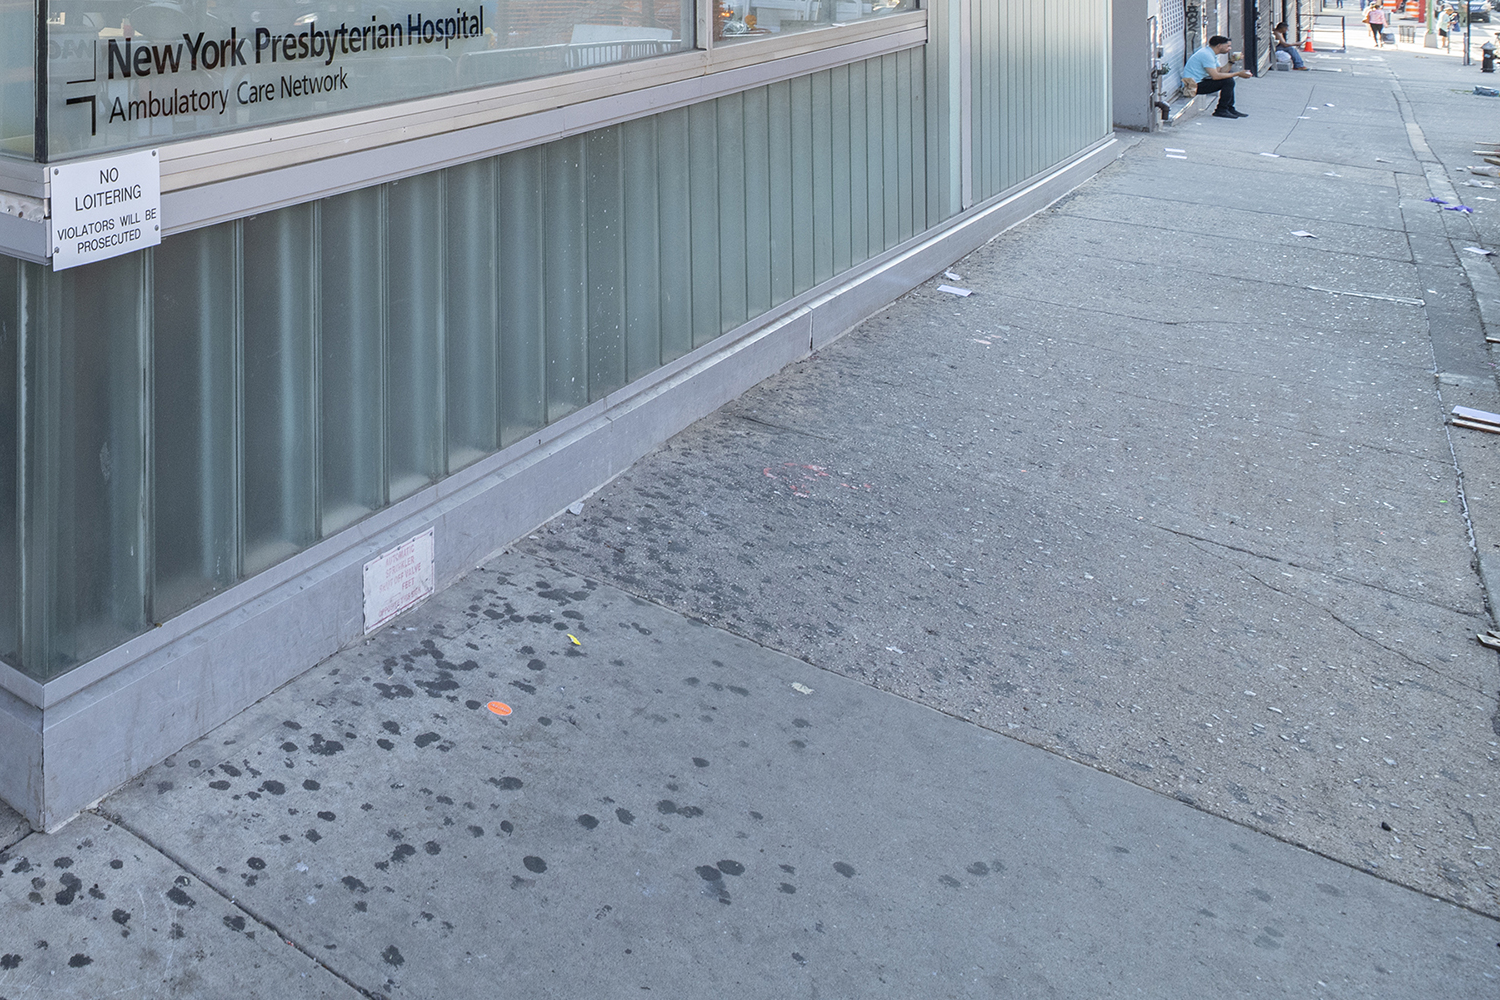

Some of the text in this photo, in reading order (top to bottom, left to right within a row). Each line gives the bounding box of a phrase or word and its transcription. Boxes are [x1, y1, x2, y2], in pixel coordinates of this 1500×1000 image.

[107, 6, 485, 80] NewYork Presbyterian Hospital
[108, 66, 349, 124] Ambulatory Care Network
[99, 167, 120, 185] NO
[75, 184, 142, 212] LOITERING
[57, 208, 157, 242] VIOLATORS WILL BE
[77, 228, 142, 255] PROSECUTED
